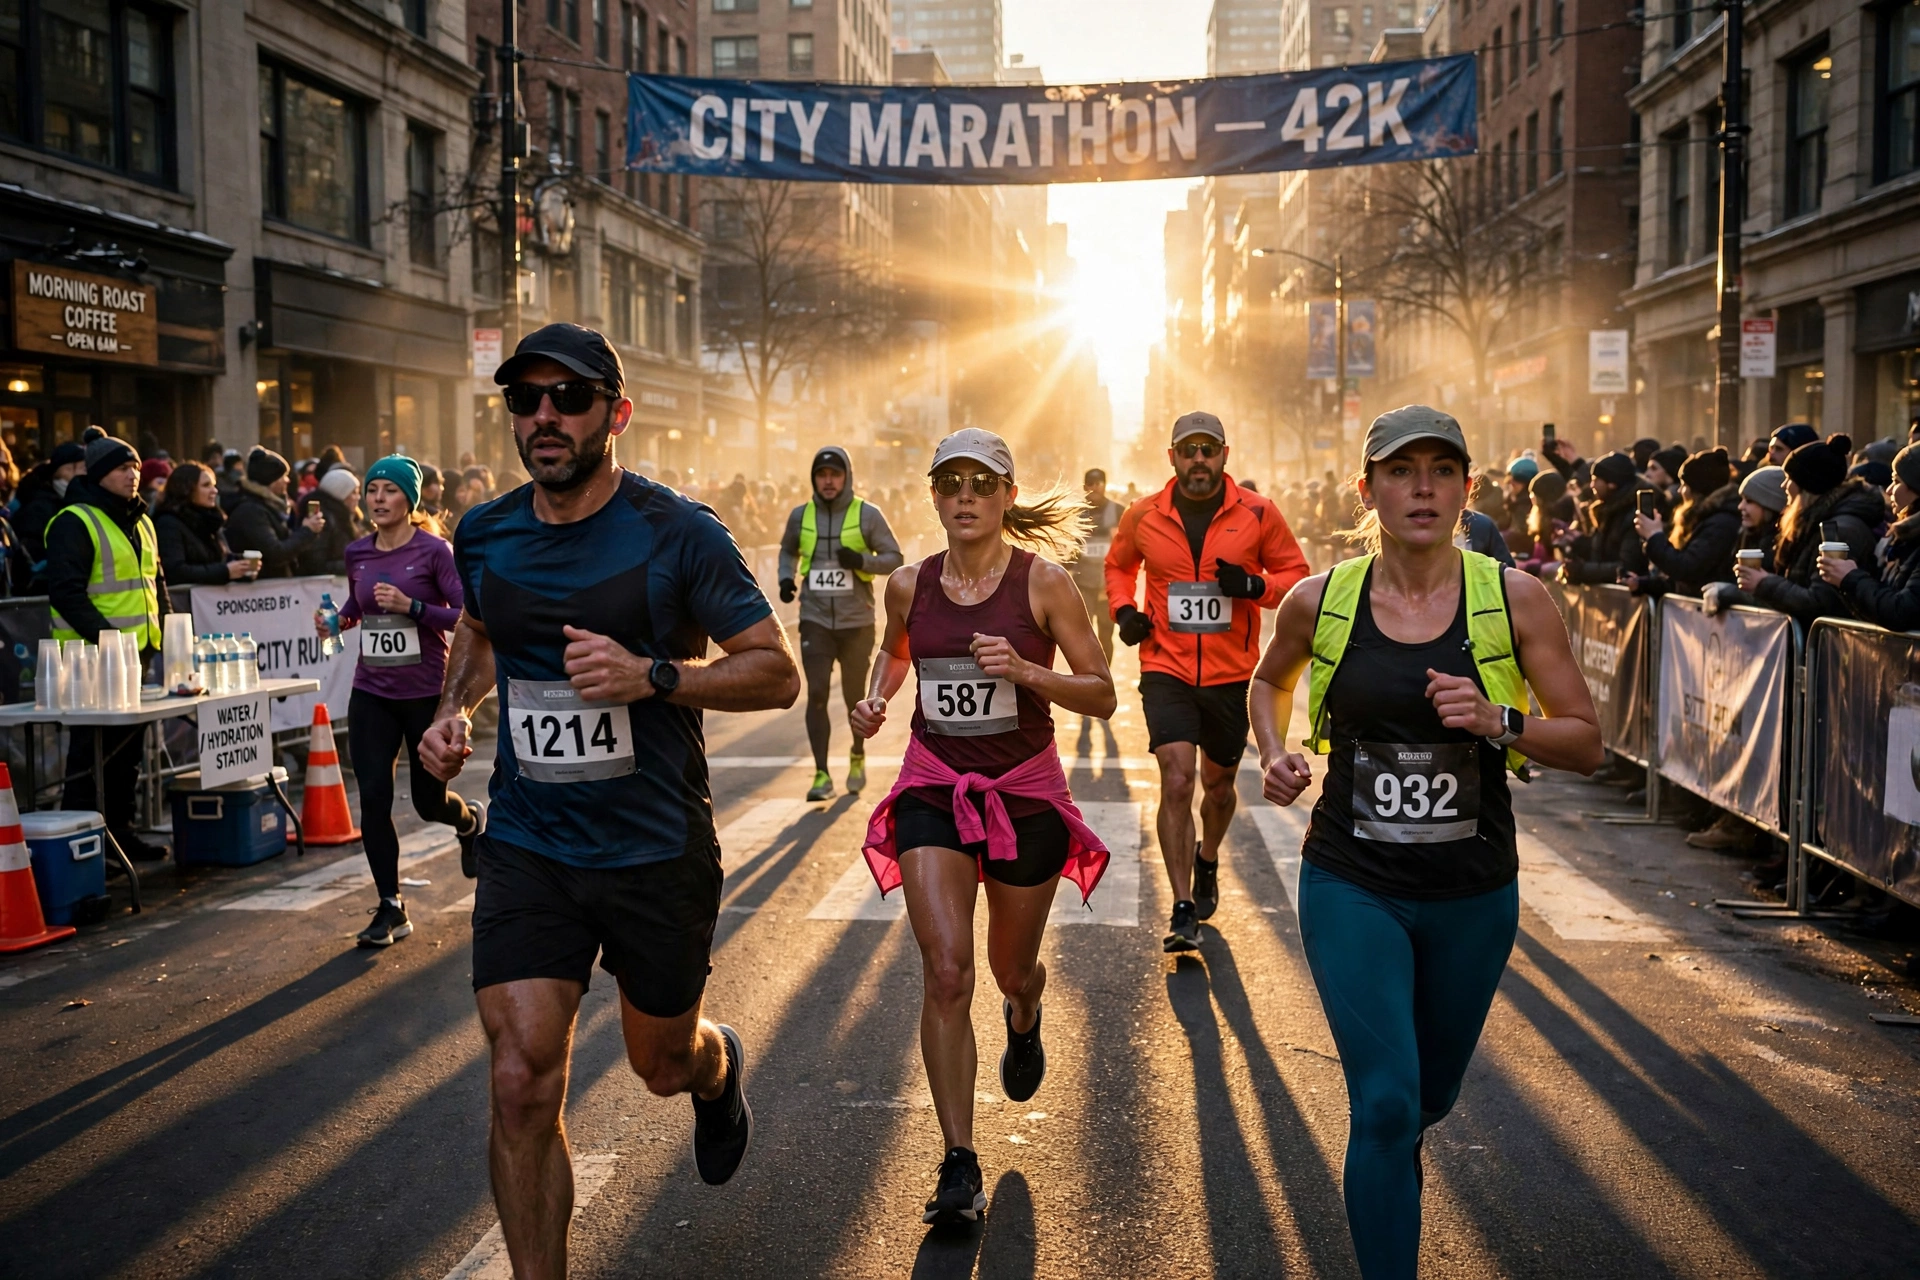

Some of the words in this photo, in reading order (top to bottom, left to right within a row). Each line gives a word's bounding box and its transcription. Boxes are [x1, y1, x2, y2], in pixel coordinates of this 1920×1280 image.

[689, 94, 829, 164] CITY
[849, 96, 1198, 168] MARATHON
[1281, 77, 1413, 153] 42K
[29, 271, 98, 305] MORNING
[102, 285, 146, 313] ROAST
[65, 305, 118, 334] COFFEE
[66, 331, 95, 351] OPEN
[96, 336, 119, 353] 6AM
[815, 571, 846, 588] 442
[216, 597, 277, 616] SPONSORED
[279, 595, 292, 610] BY
[1180, 598, 1221, 621] 310
[257, 639, 292, 672] CITY
[369, 631, 406, 654] 760
[937, 682, 997, 717] 587
[217, 704, 251, 725] WATER
[207, 722, 264, 750] HYDRATION
[521, 712, 618, 757] 1214
[216, 745, 258, 770] STATION
[1374, 772, 1458, 818] 932
